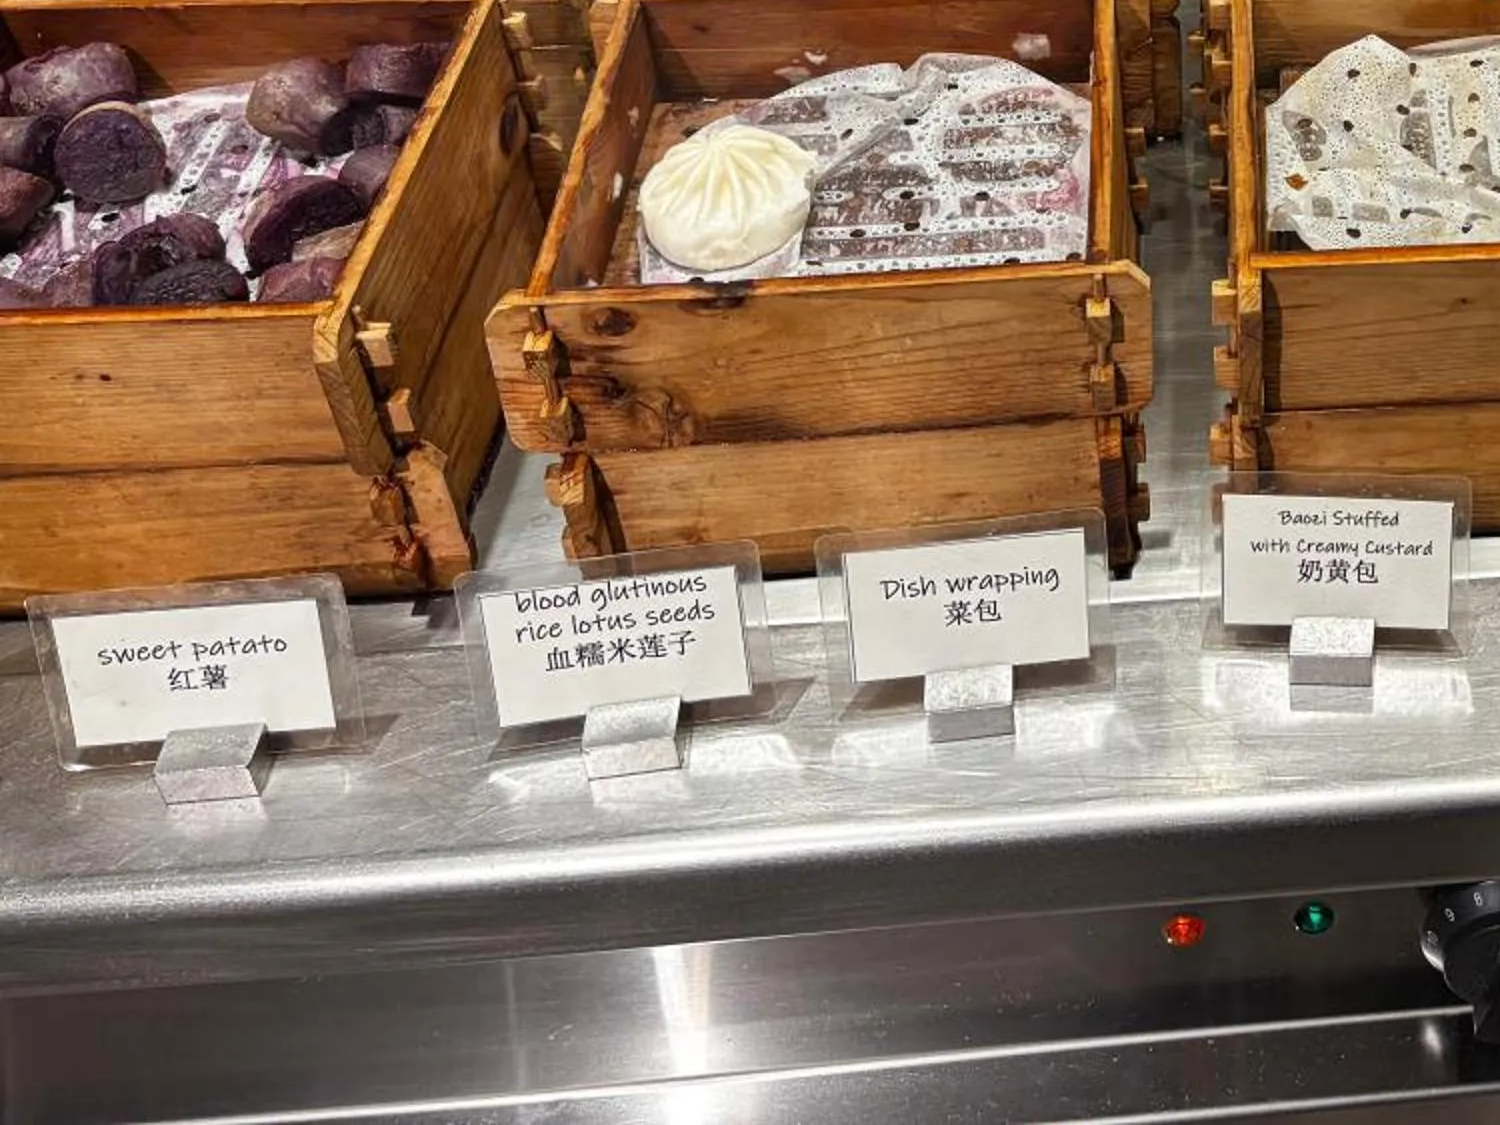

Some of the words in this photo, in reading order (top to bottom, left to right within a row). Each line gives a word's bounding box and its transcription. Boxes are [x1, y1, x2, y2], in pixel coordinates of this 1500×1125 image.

[1277, 511, 1328, 526] Baozi
[1333, 510, 1400, 528] Stuffed
[1251, 539, 1290, 554] with
[1296, 539, 1359, 556] Creamy
[1365, 540, 1434, 557] Custard
[880, 575, 937, 601] Dish
[945, 566, 1060, 595] wrapping
[1297, 558, 1379, 584] 奶黄包
[515, 586, 580, 614] blood
[590, 575, 708, 611] glutinous
[515, 621, 564, 645] rice
[571, 613, 638, 637] lotus
[645, 600, 716, 627] seeds
[943, 598, 1003, 626] 菜包
[97, 640, 184, 666] sweet
[192, 635, 288, 662] patato
[545, 630, 696, 673] 血糯米莲子
[167, 664, 230, 692] 红薯
